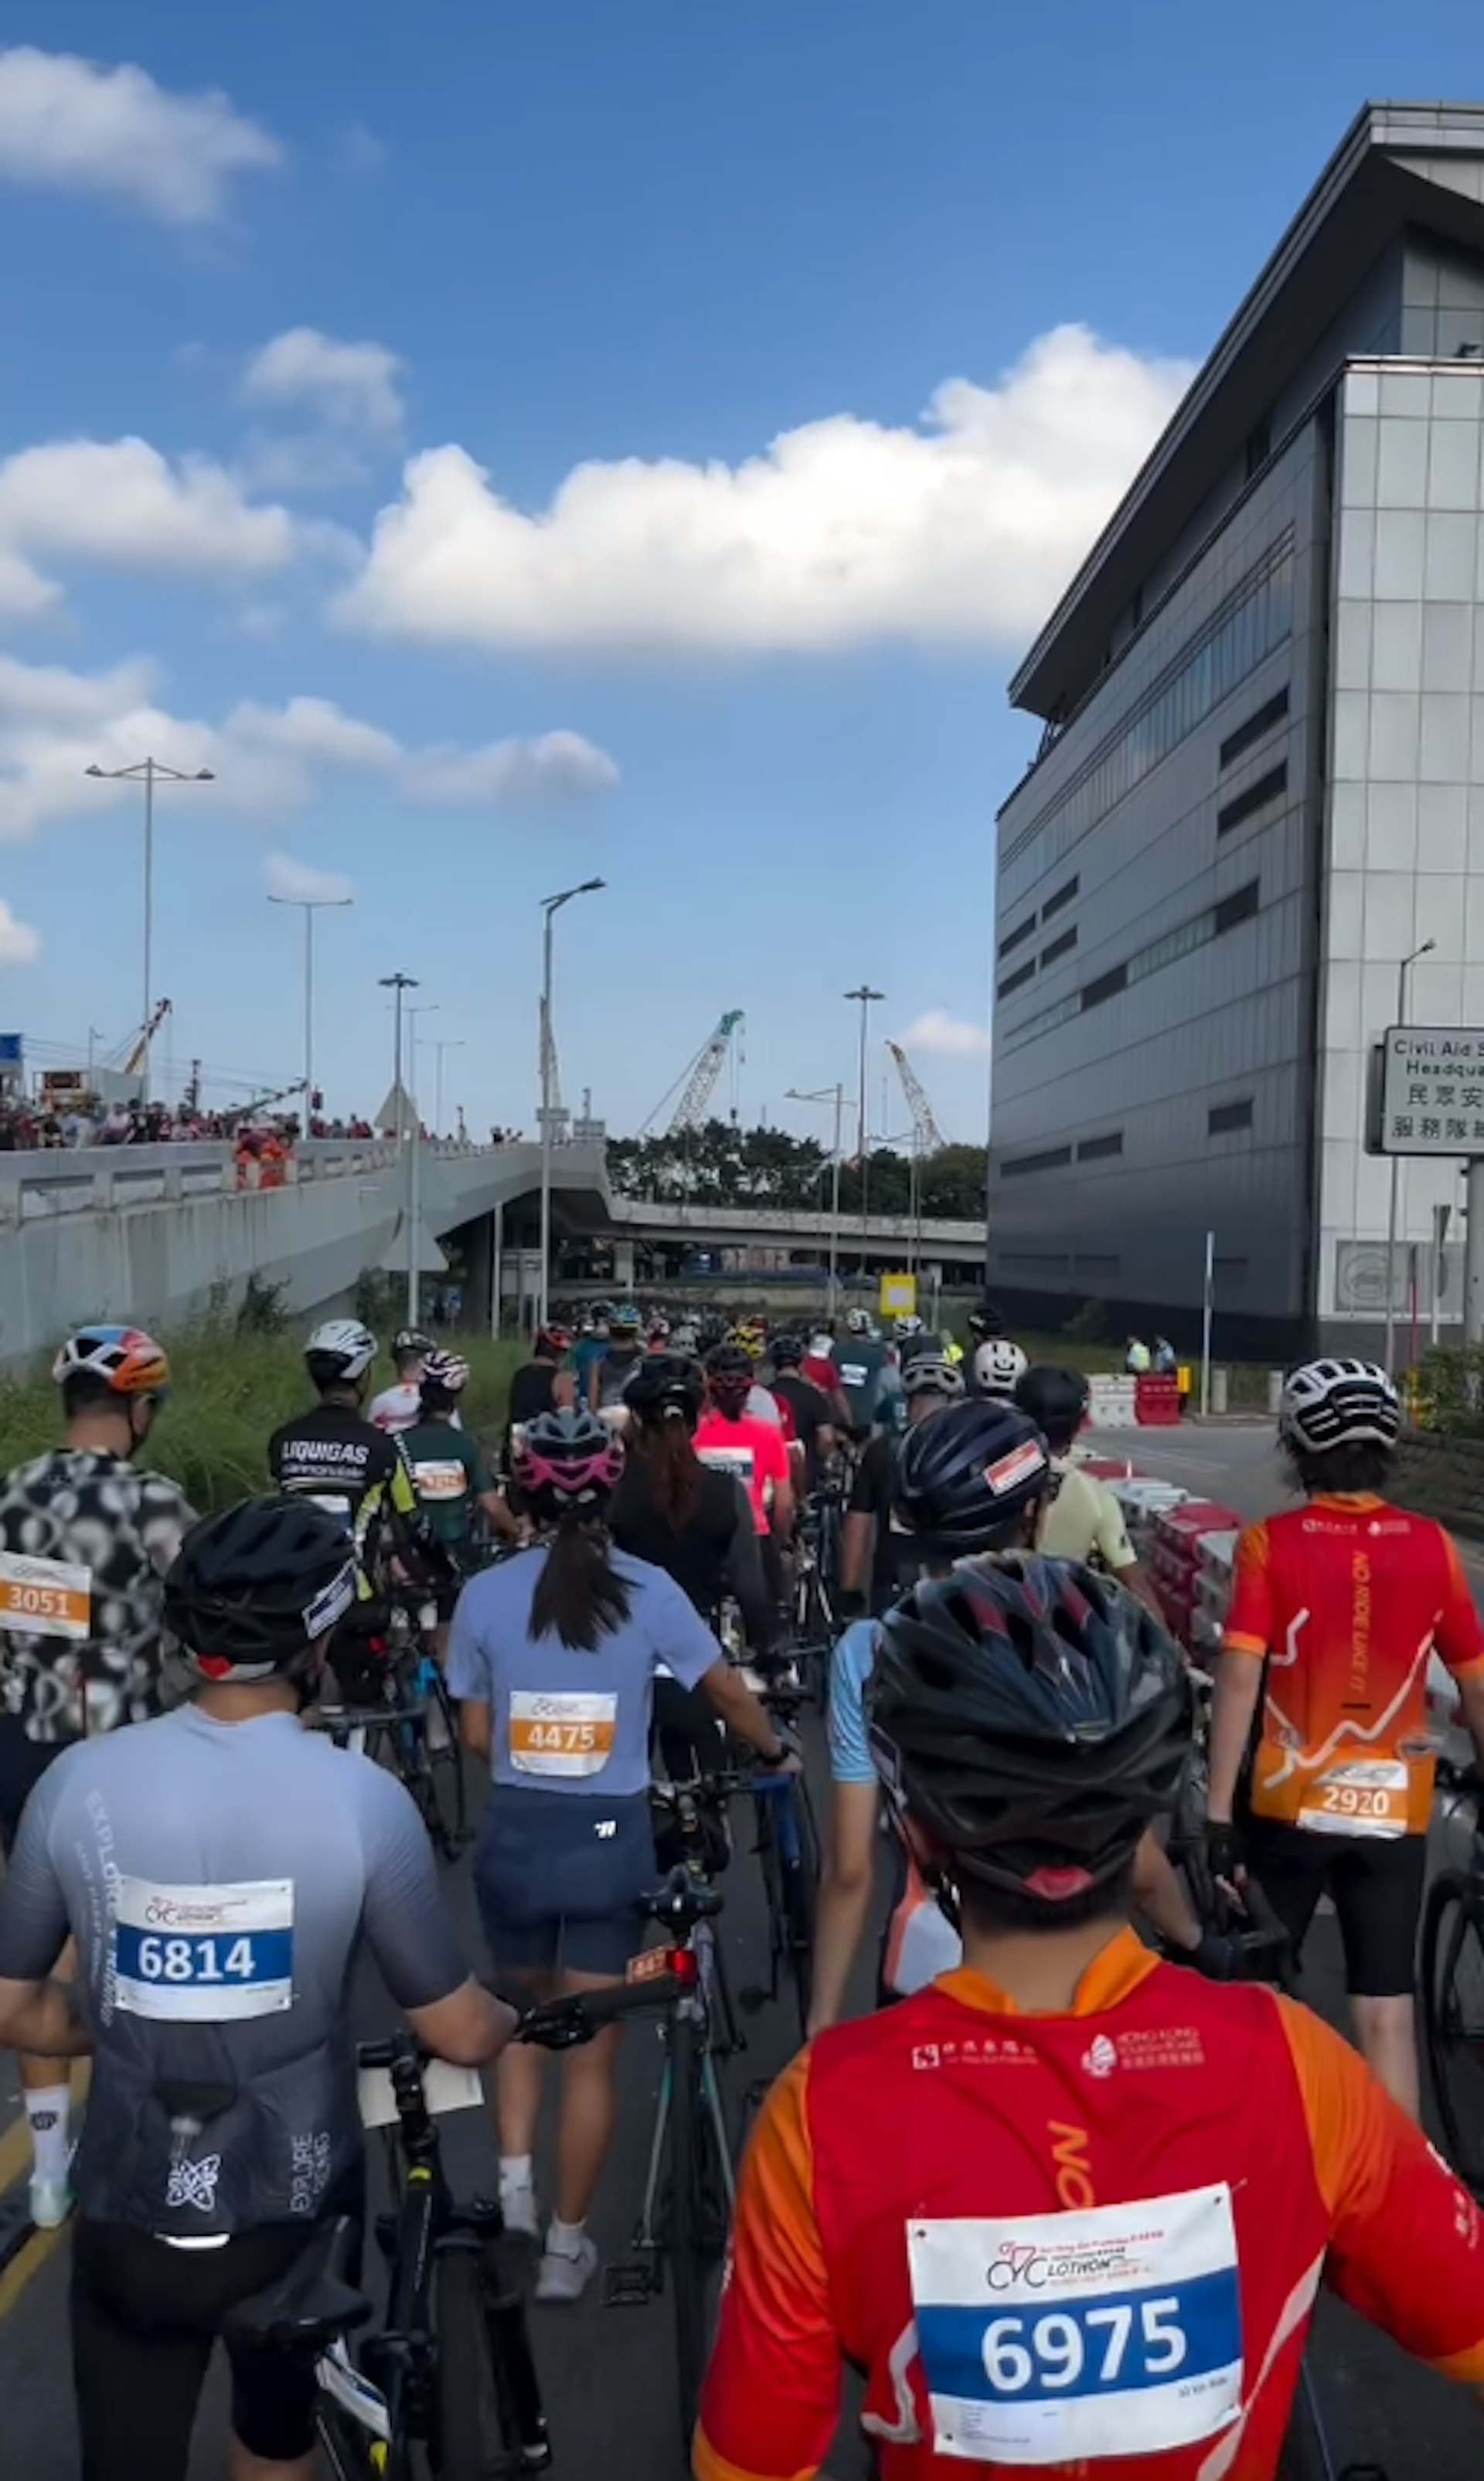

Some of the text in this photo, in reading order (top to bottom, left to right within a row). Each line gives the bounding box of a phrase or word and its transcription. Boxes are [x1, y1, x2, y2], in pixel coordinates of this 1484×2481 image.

[1394, 1040, 1435, 1057] Civil
[1441, 1041, 1471, 1057] Aid
[282, 1441, 370, 1465] LIQUIGAS
[9, 1585, 70, 1617] 3051
[528, 1723, 595, 1751] 4475
[1322, 1785, 1390, 1816] 2920
[138, 1936, 256, 1981] 6814
[1047, 2119, 1094, 2210] NO
[982, 2296, 1187, 2391] 6975
